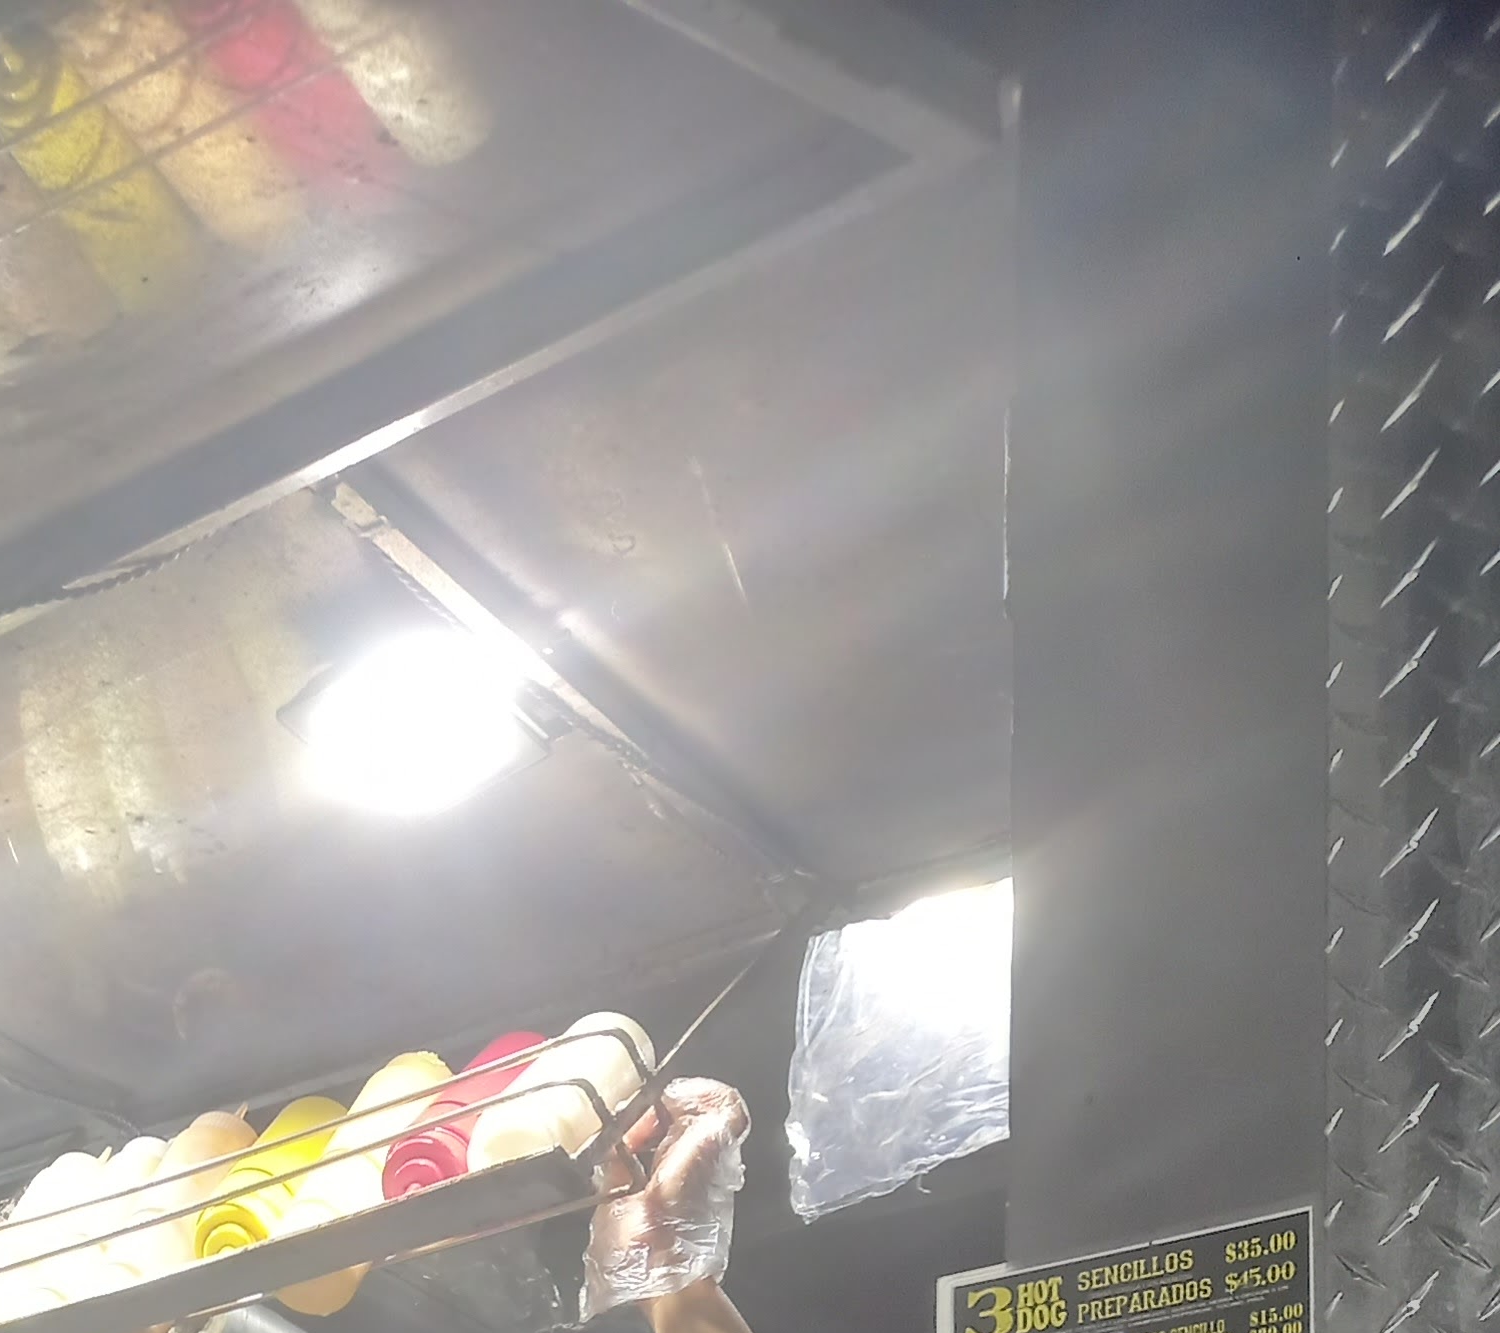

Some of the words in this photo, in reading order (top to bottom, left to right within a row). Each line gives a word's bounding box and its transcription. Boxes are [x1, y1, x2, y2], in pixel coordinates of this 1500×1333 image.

[1077, 1249, 1194, 1291] SENCILLOS
[1225, 1230, 1297, 1263] $35.00
[1017, 1276, 1063, 1307] HOT
[1077, 1278, 1212, 1324] PREPARADOS
[1225, 1261, 1296, 1293] $45.00
[1249, 1303, 1303, 1326] $15.00
